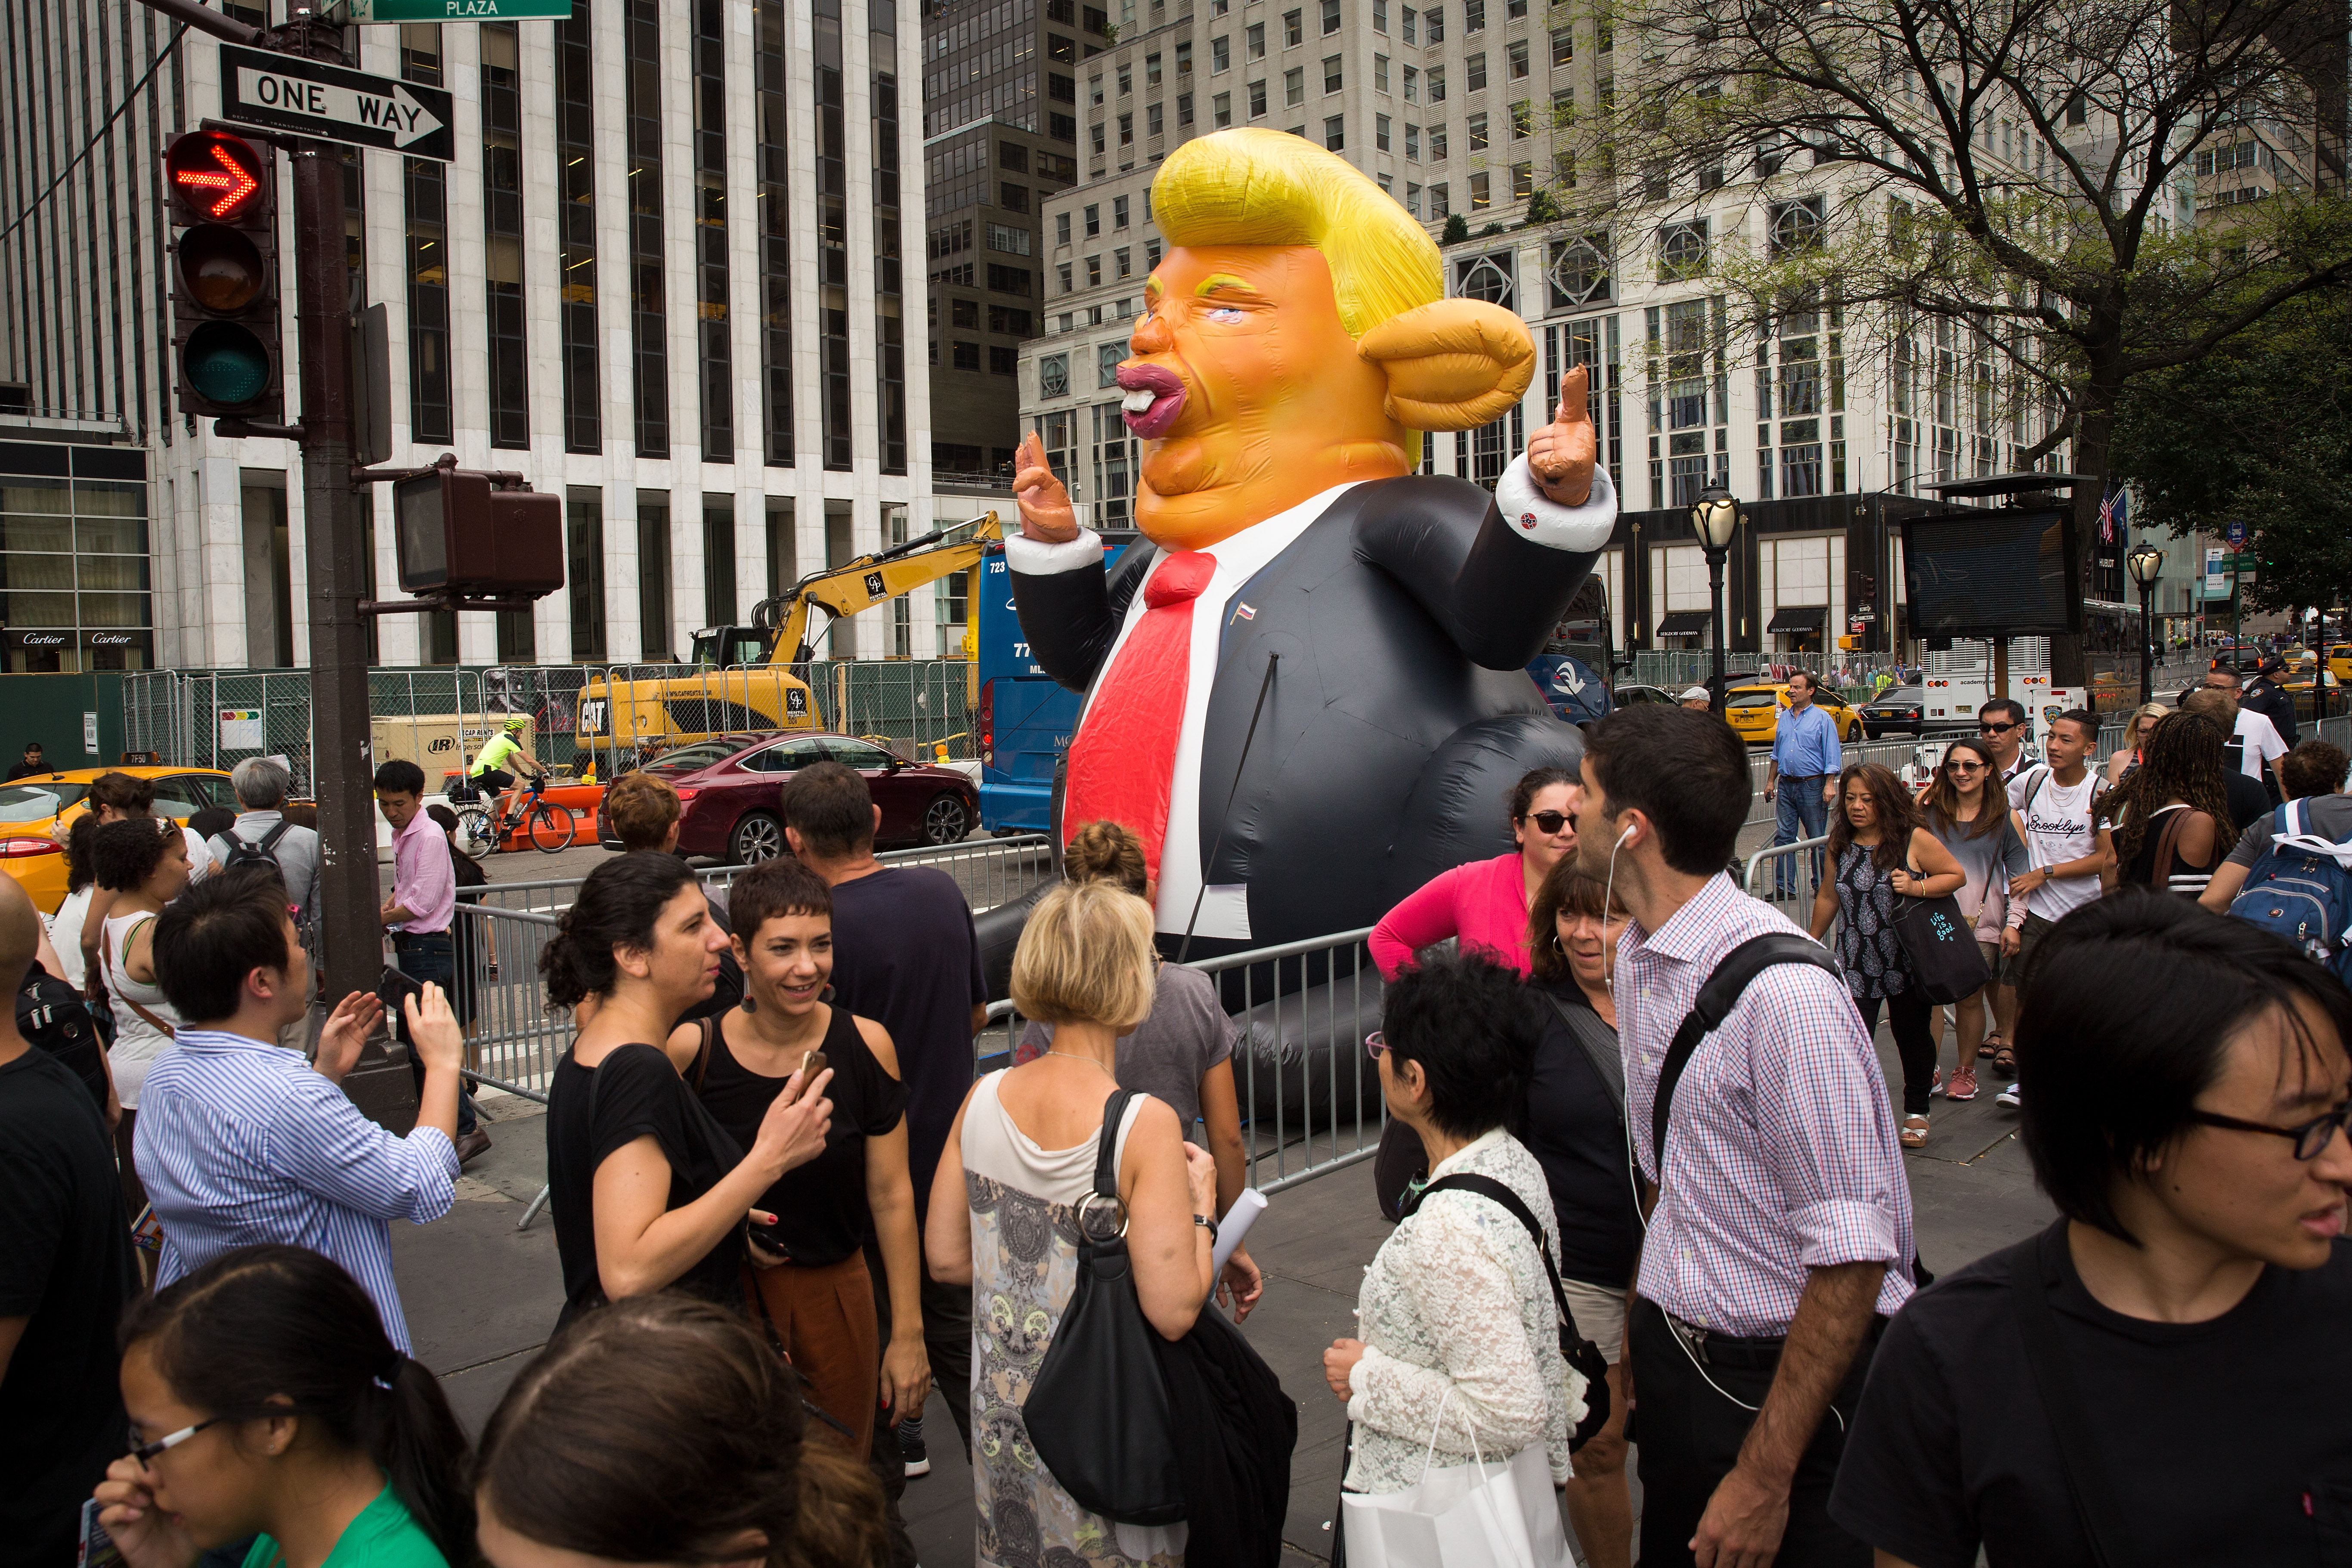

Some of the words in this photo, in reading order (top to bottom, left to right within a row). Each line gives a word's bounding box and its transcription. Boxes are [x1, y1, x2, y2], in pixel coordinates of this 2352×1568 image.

[447, 1, 498, 16] PLAZA
[258, 75, 326, 115] ONE
[357, 95, 422, 133] WAY
[990, 562, 1005, 574] 723
[2099, 558, 2114, 567] HUBLOT
[869, 577, 881, 592] CAP
[23, 633, 65, 644] Cartier
[92, 632, 131, 643] Cartier
[1014, 643, 1031, 657] 77
[1030, 665, 1046, 674] ML
[790, 691, 802, 708] CAP
[582, 702, 605, 732] CAT
[131, 755, 146, 763] 7F50
[2030, 814, 2086, 839] Brooklyn
[1930, 912, 1945, 926] Life
[1937, 922, 1955, 941] good.
